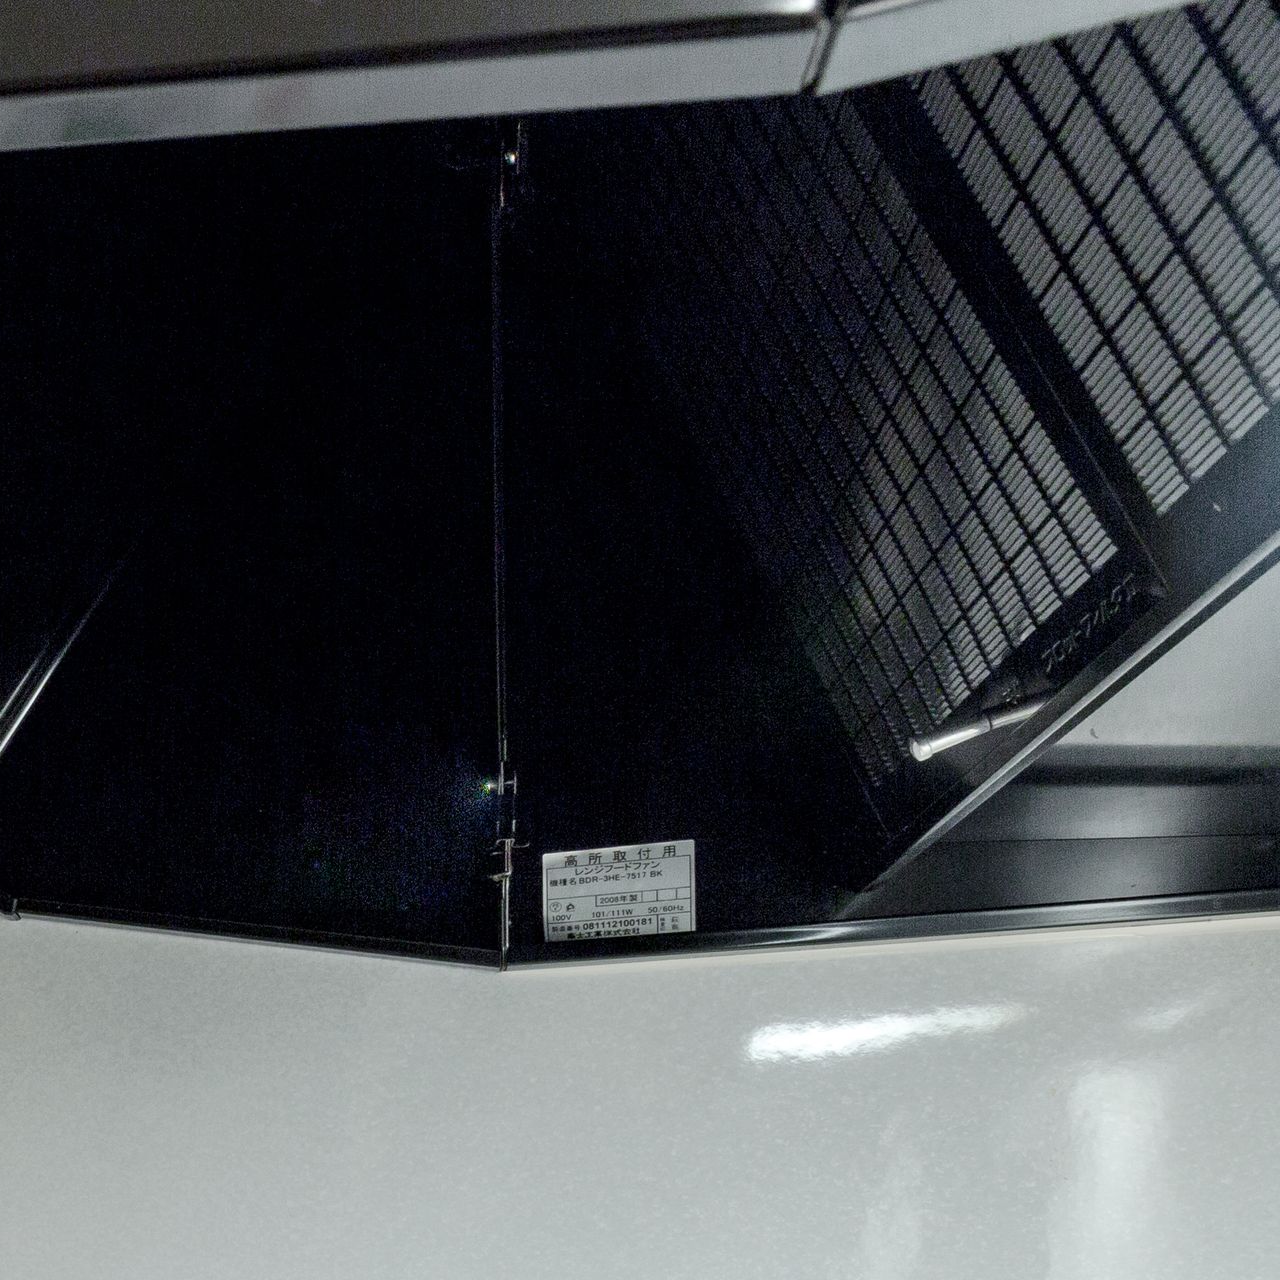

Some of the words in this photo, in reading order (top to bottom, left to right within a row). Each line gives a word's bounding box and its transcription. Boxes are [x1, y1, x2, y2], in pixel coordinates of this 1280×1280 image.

[575, 861, 660, 876] レンジフードファン
[650, 870, 663, 878] BK
